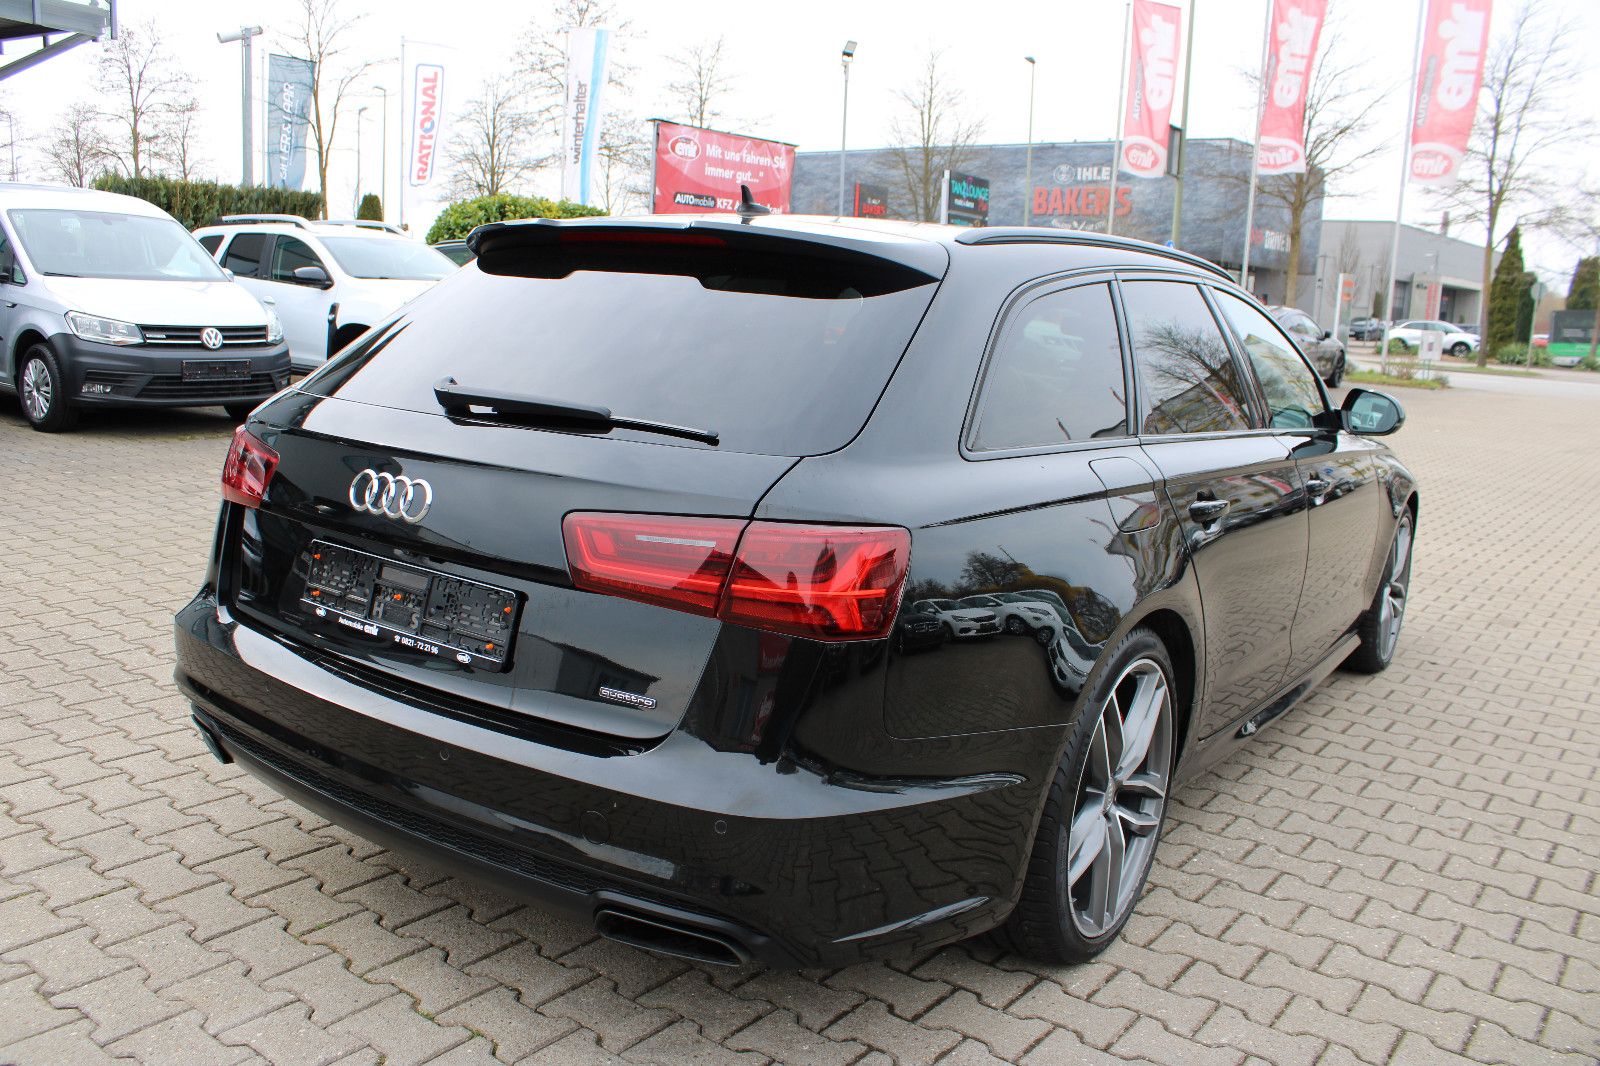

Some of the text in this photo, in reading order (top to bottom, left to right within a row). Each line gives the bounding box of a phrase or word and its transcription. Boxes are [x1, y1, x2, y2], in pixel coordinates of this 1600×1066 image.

[1141, 14, 1176, 111] emir
[1276, 7, 1318, 108] emir
[1437, 2, 1485, 111] emir
[417, 71, 438, 180] RATIONAL
[570, 80, 587, 164] winterhalter
[706, 144, 722, 158] Mit
[724, 150, 740, 162] uns
[743, 149, 771, 167] fahren
[1128, 149, 1155, 169] emir
[705, 162, 734, 178] immer
[1077, 166, 1111, 181] IHLE
[717, 197, 733, 210] KFZ
[602, 689, 653, 706] quattro
